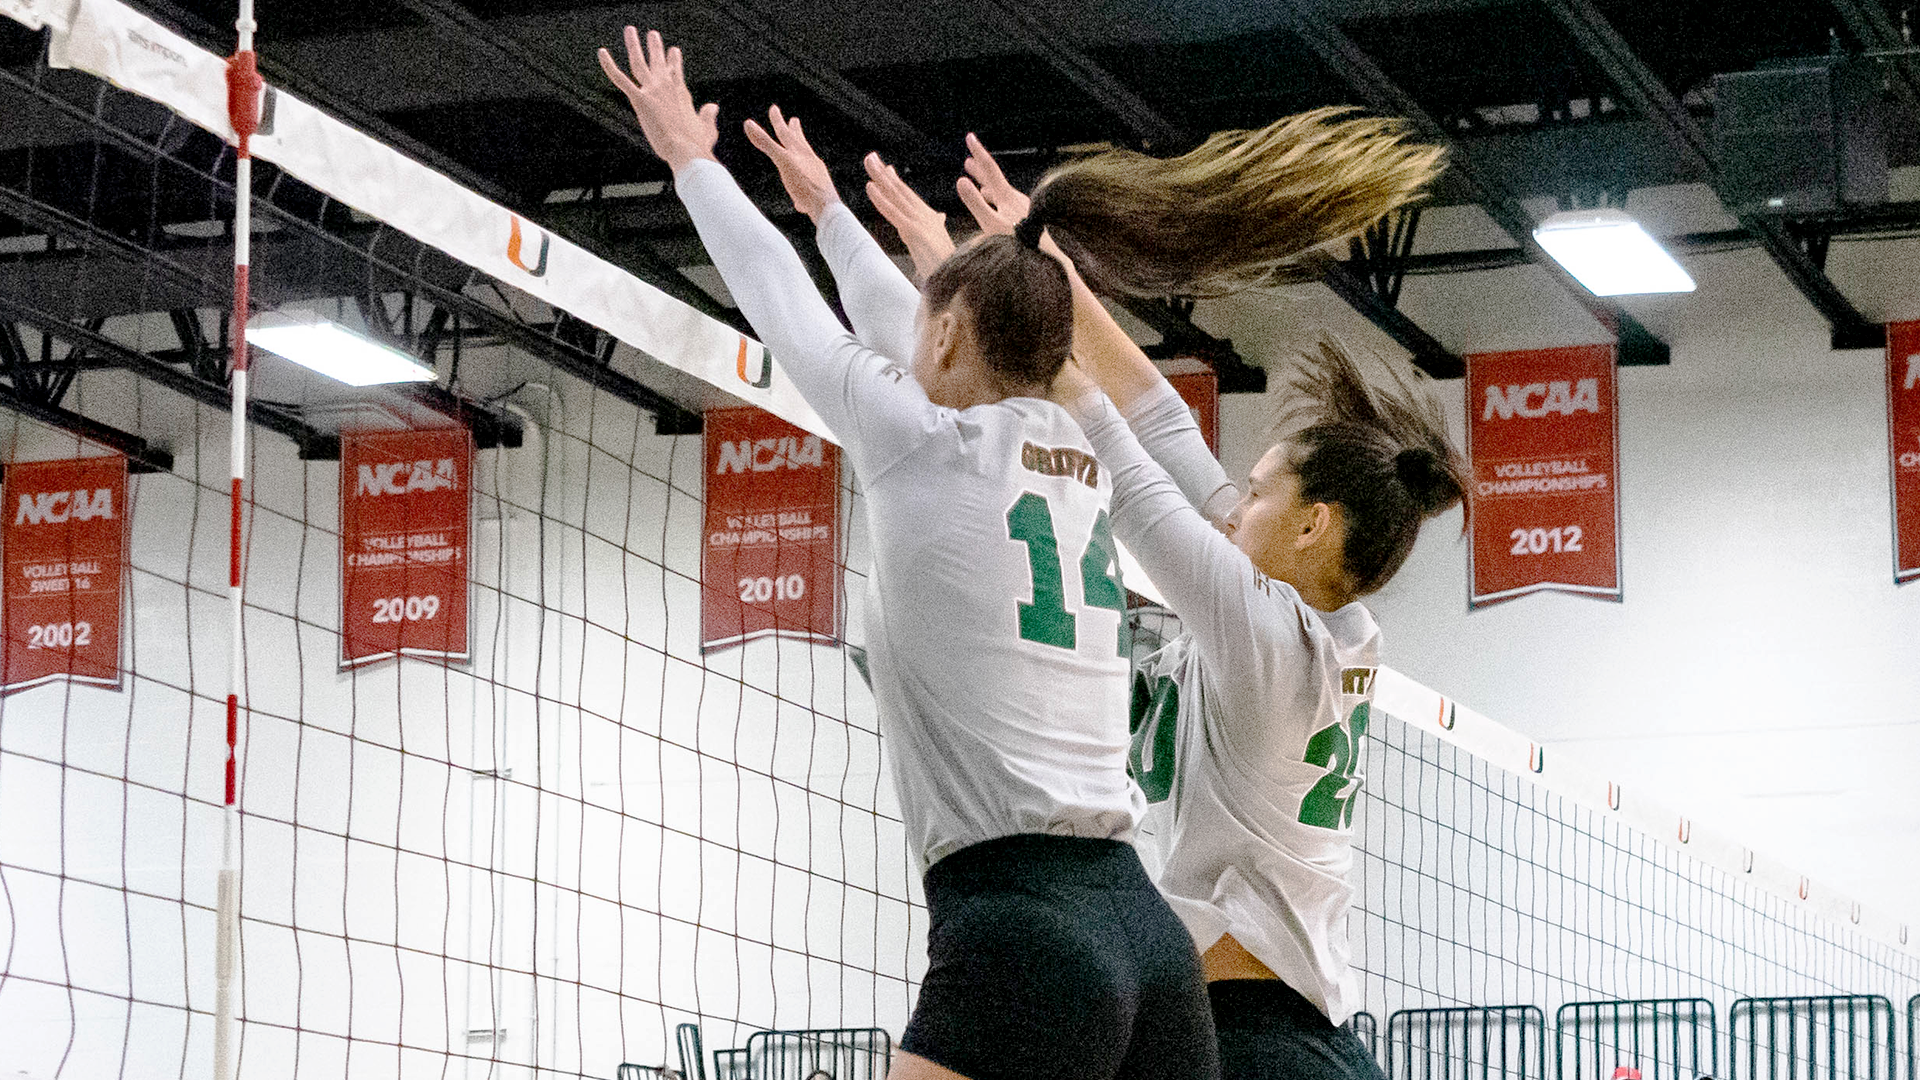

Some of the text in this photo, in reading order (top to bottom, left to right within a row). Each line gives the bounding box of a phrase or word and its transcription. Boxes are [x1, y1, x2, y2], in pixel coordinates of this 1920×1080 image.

[1483, 378, 1599, 421] NCAA
[716, 436, 823, 475] NCAA
[1494, 459, 1589, 478] VOLLEYBALL
[357, 458, 457, 497] NCAA
[1477, 474, 1608, 496] CHAMPIONSHIPS
[15, 489, 112, 525] NCAA
[1510, 526, 1583, 556] 2012
[75, 576, 92, 590] 16
[738, 574, 804, 604] 2010
[1006, 490, 1131, 658] 14
[372, 595, 440, 624] 2009
[27, 621, 91, 650] 2002
